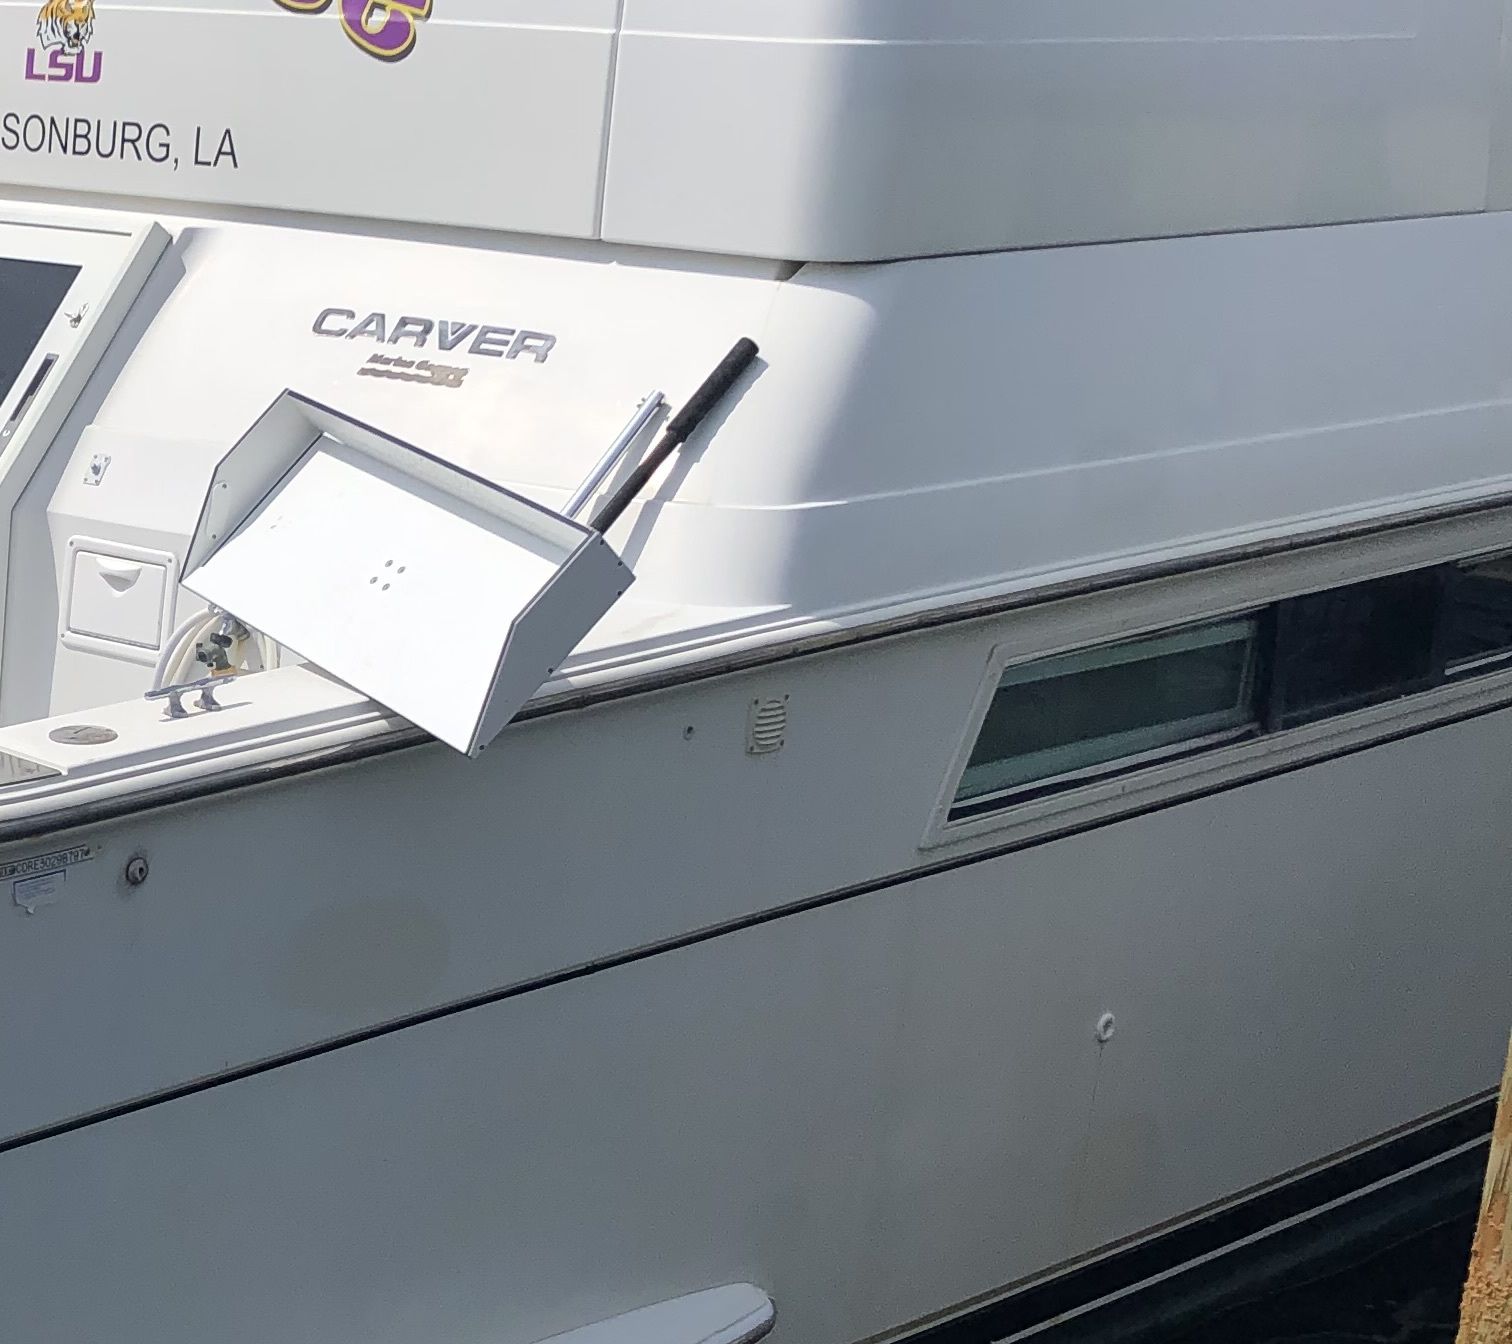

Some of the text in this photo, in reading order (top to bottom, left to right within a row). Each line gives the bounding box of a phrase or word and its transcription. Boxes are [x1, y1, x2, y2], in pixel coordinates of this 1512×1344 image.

[24, 47, 103, 84] LSU
[193, 125, 240, 170] LA
[311, 307, 558, 364] CARVER
